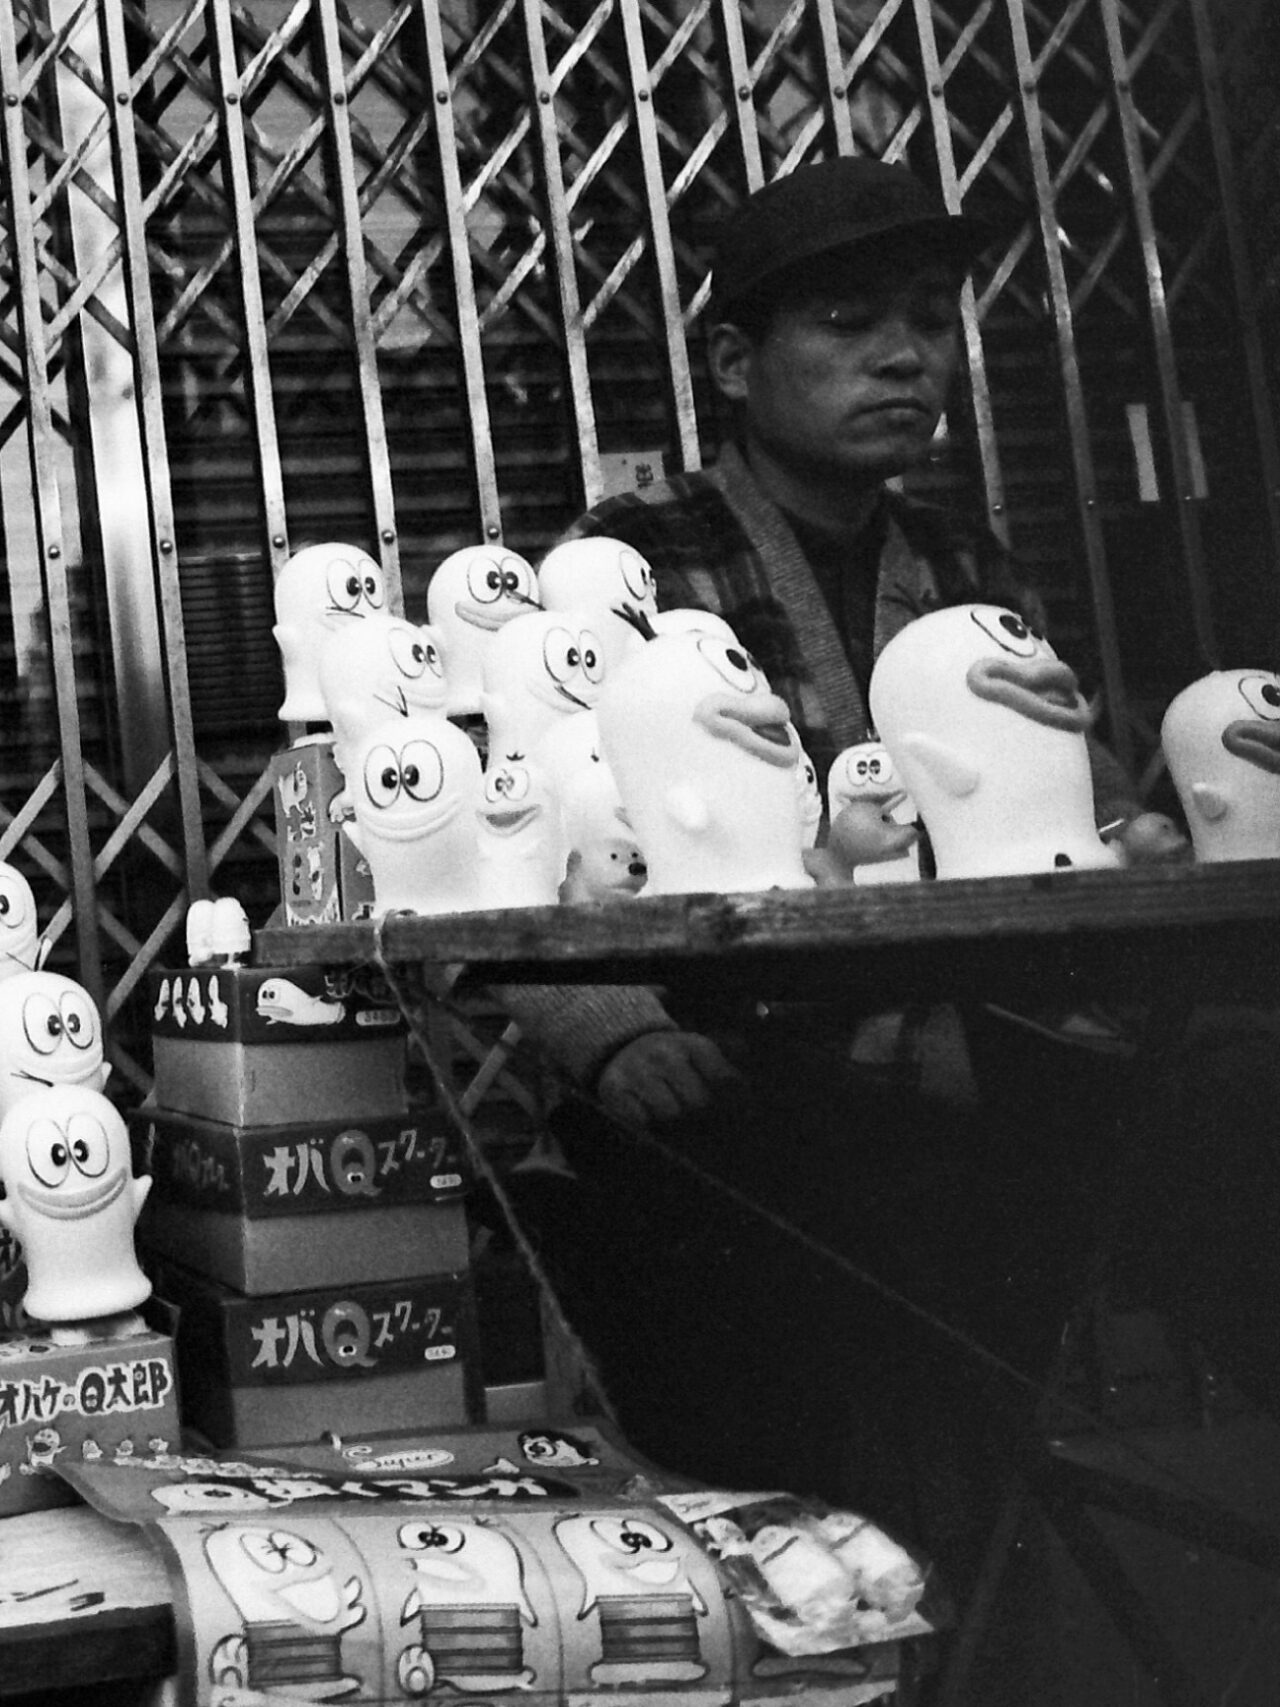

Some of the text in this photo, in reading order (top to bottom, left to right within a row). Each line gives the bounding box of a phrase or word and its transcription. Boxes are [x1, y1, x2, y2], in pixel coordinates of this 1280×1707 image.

[250, 1300, 453, 1369] オバQスクーター
